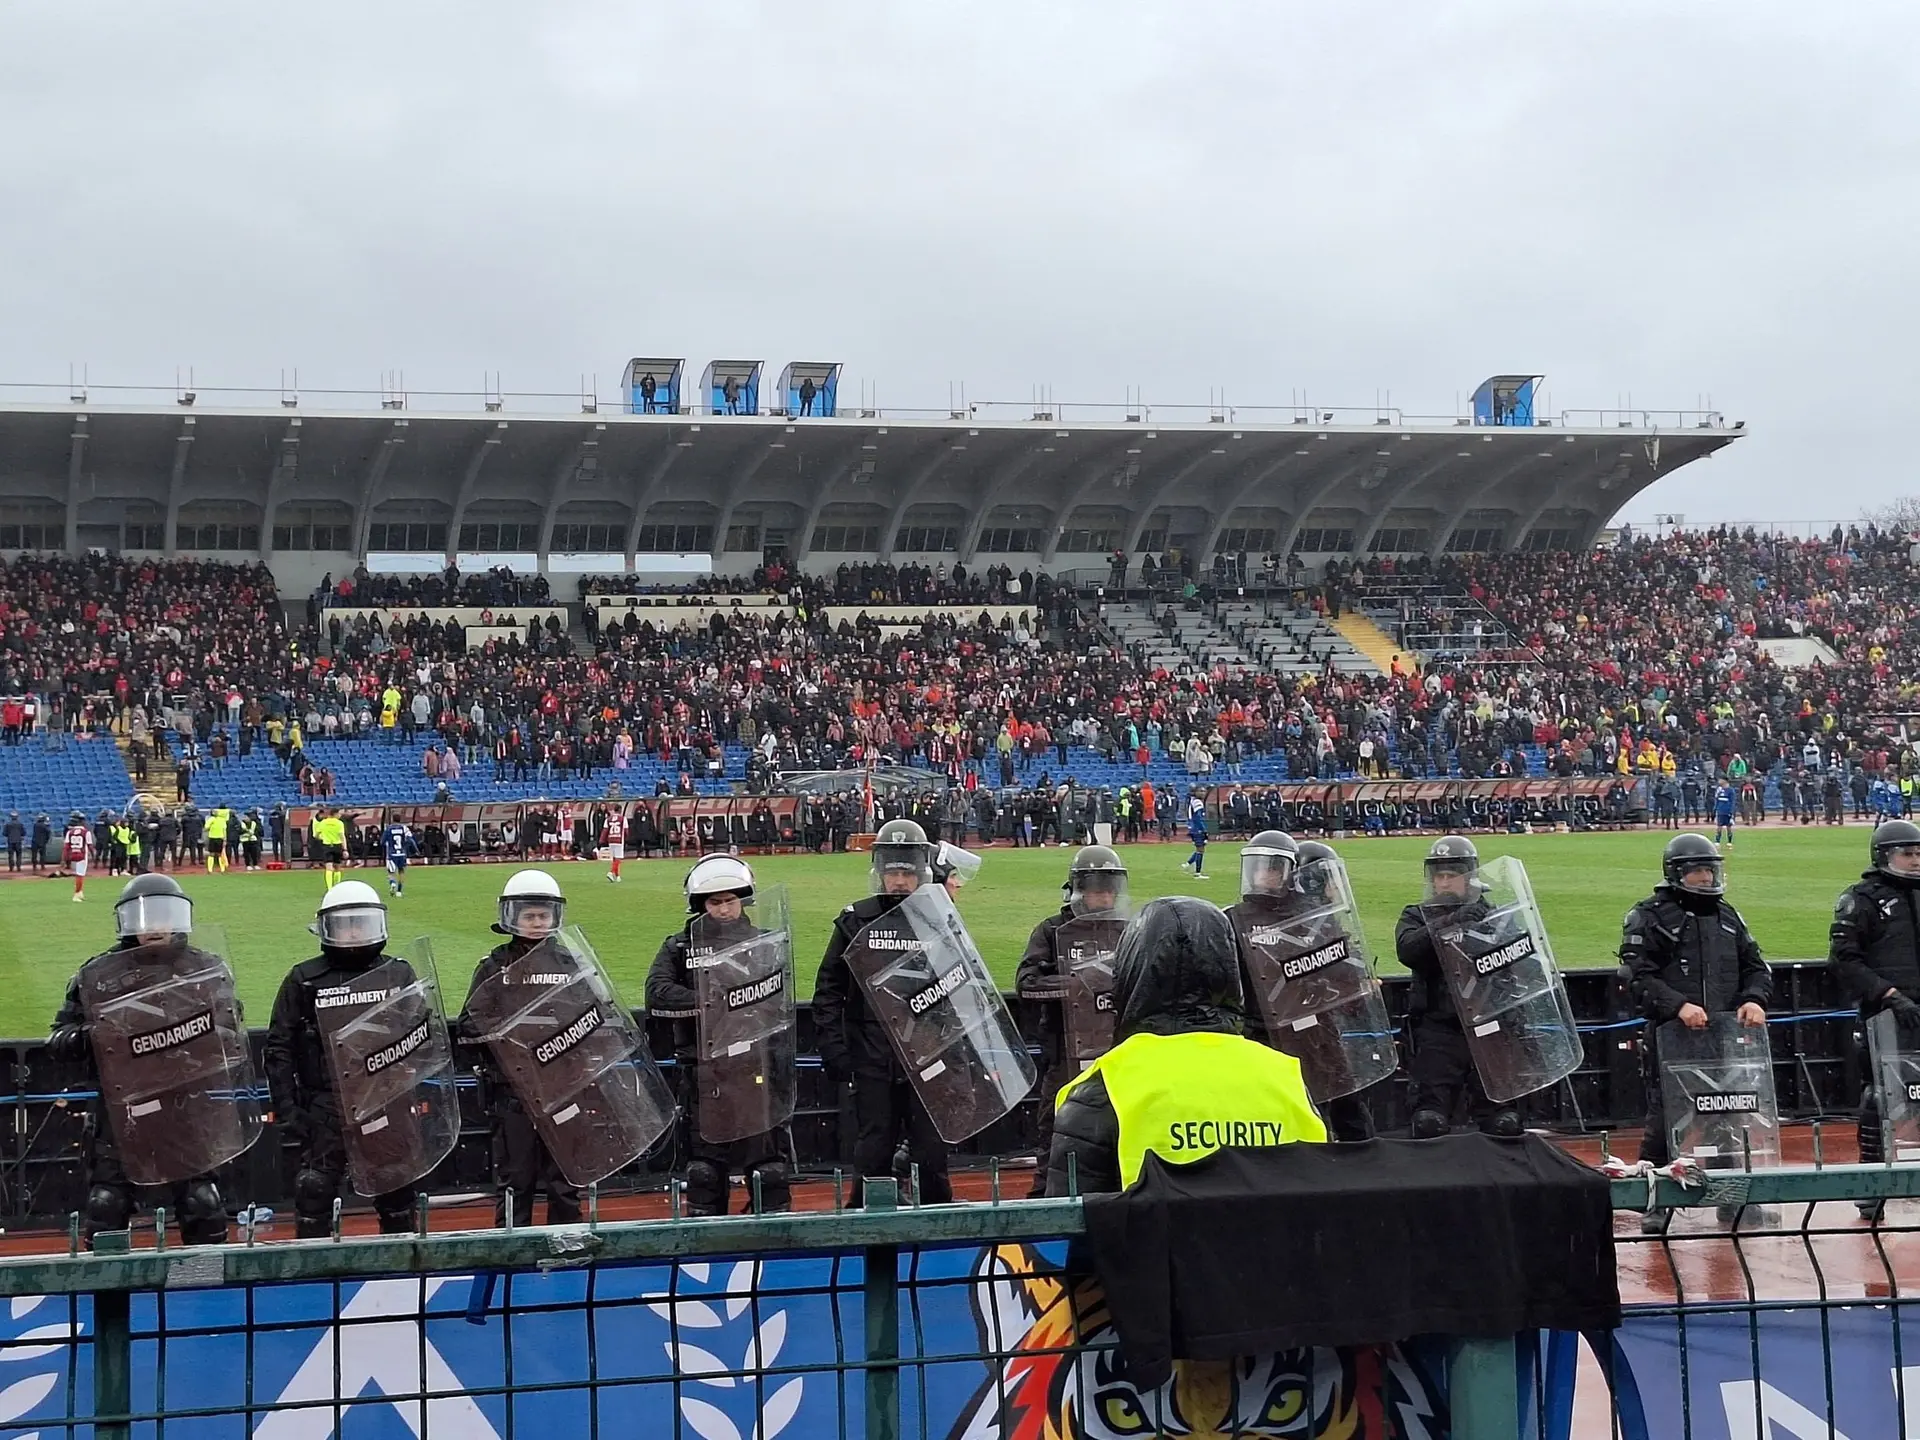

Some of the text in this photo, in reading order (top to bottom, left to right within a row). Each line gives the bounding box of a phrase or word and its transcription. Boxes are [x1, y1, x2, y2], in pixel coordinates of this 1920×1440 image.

[1283, 940, 1346, 977] GENDARMERY
[1476, 937, 1532, 974] GENDARMERY
[503, 973, 572, 984] GDARMERY
[729, 972, 782, 1007] GENDARMERY
[910, 963, 966, 1013] GENDARMERY
[132, 1013, 212, 1054] GENDARMERY
[367, 1021, 429, 1072] GENDARMERY
[536, 1007, 600, 1063] GENDARMERY
[1696, 1094, 1757, 1111] GENDARMERY
[1170, 1121, 1282, 1150] SECURITY
